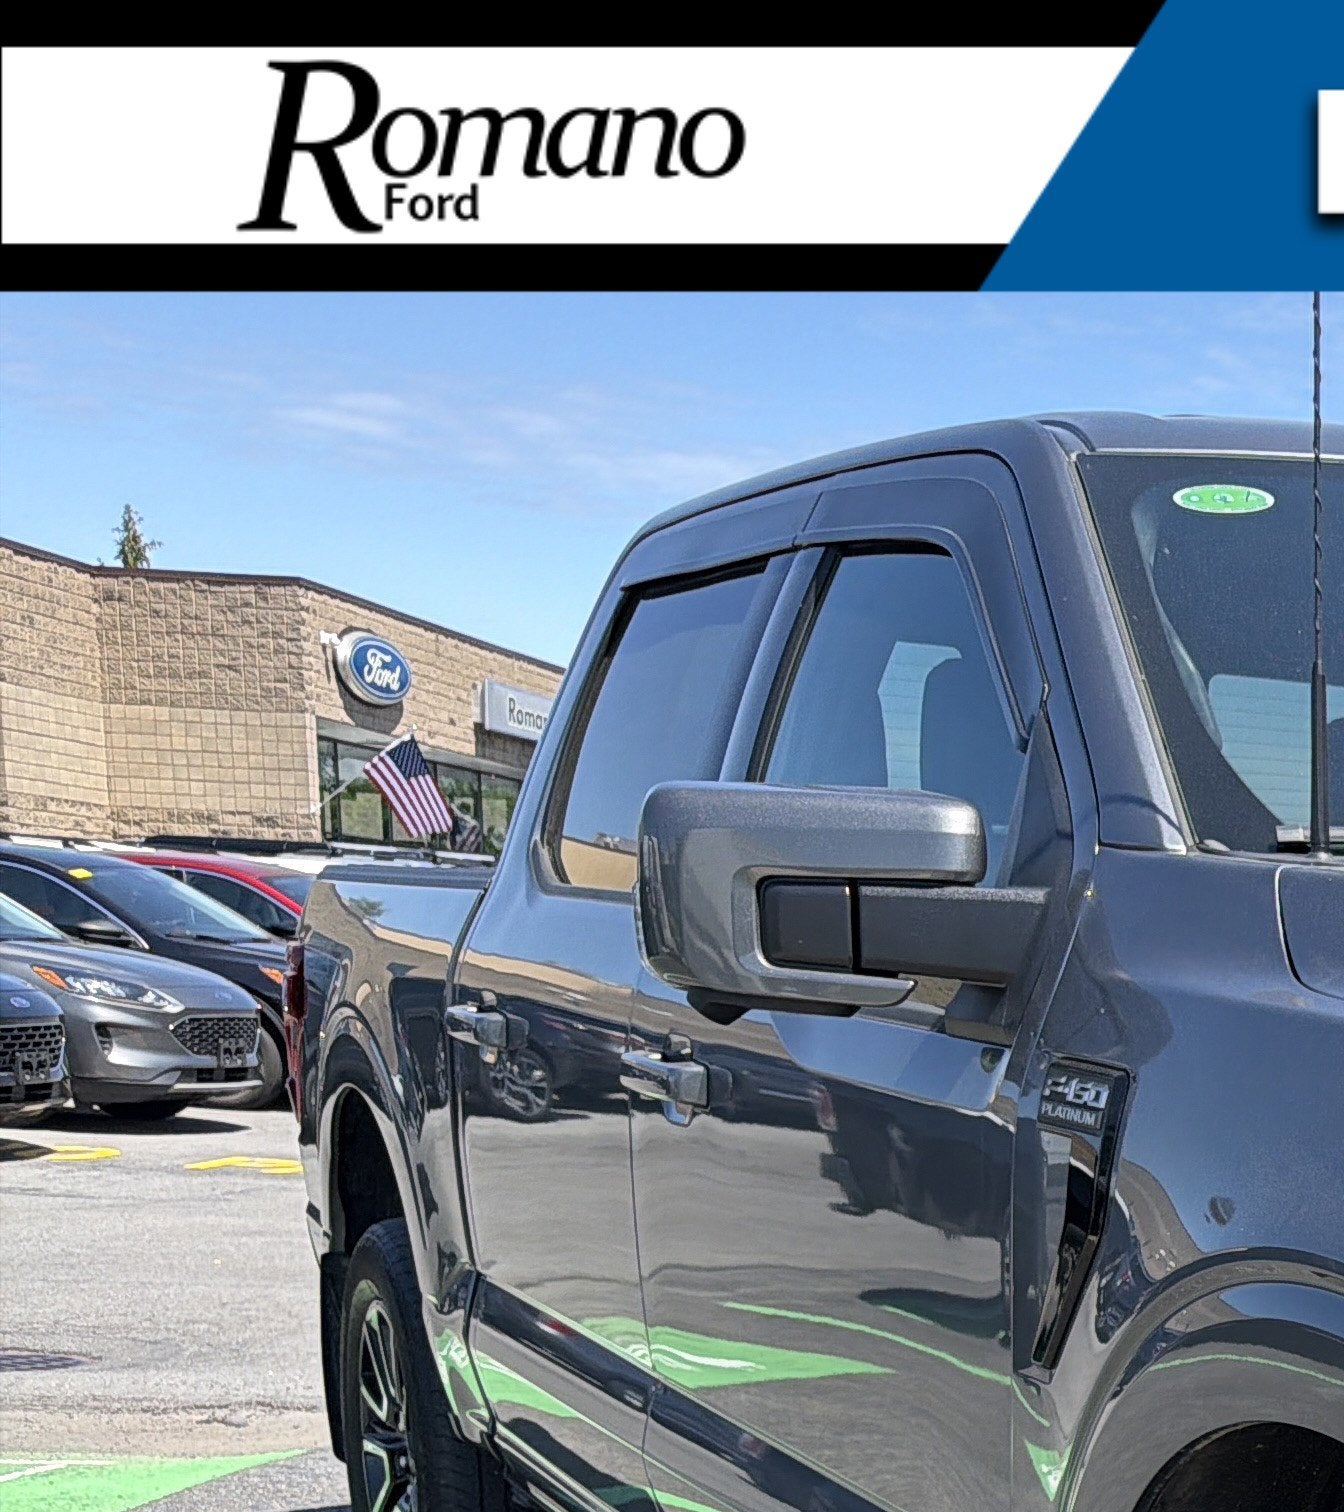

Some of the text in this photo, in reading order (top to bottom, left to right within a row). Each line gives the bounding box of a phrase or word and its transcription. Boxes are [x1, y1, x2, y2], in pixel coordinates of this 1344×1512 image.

[363, 647, 401, 691] Ford
[508, 697, 549, 730] Roma
[1040, 1101, 1097, 1126] PLATINUM
